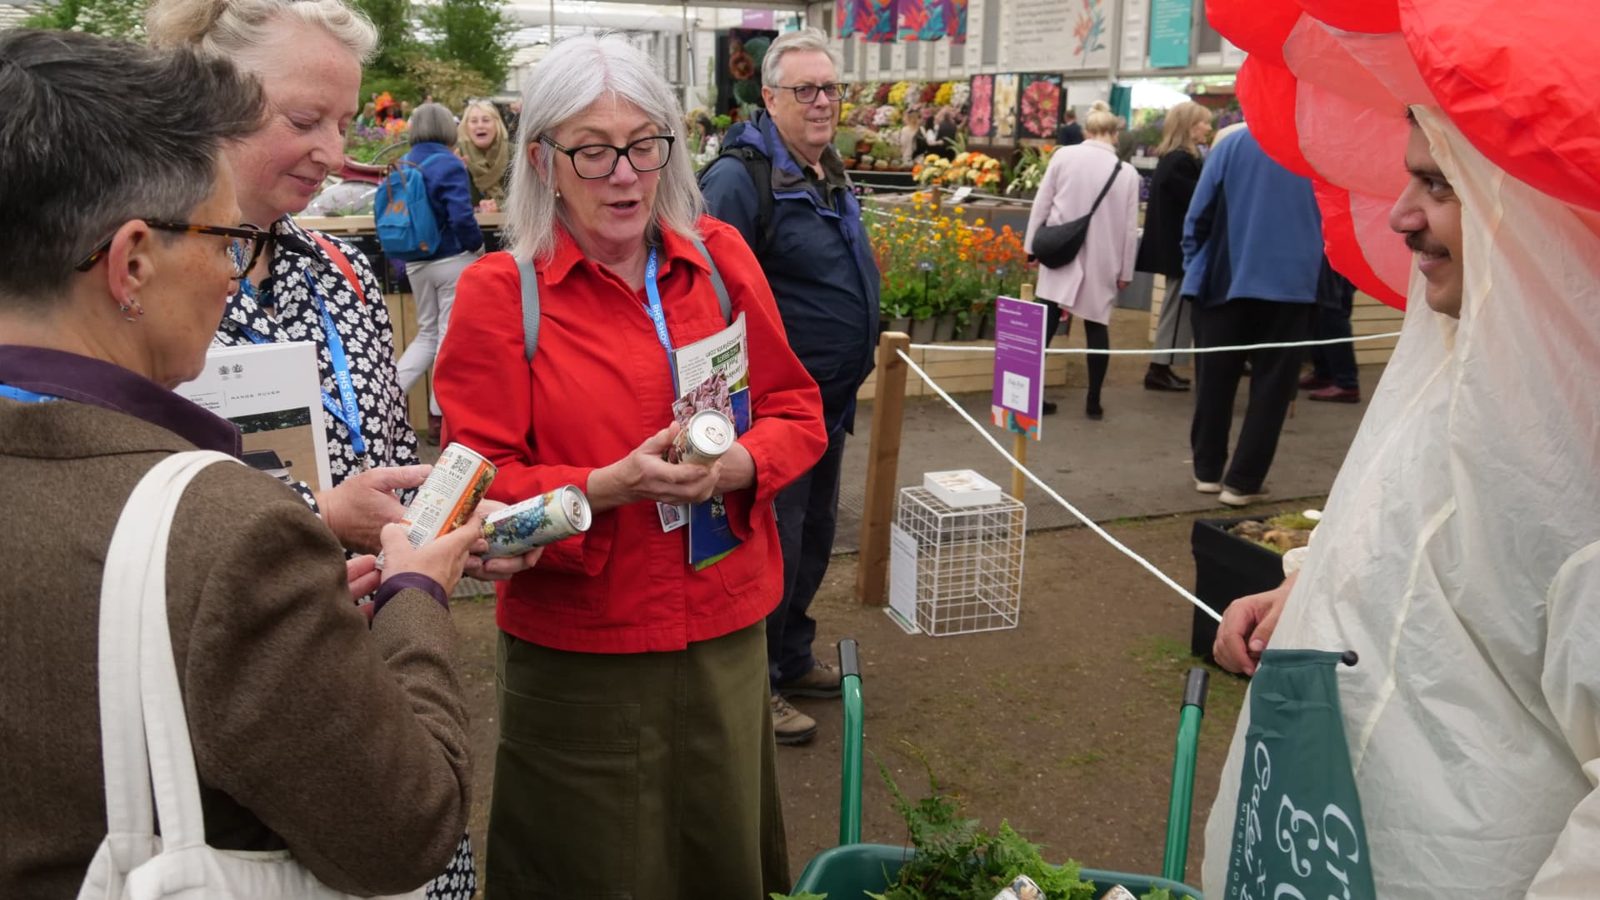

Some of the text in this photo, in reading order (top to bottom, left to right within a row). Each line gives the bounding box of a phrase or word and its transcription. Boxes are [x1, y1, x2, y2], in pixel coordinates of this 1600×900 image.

[652, 304, 662, 321] RHS
[338, 370, 357, 428] RHS SHOWS
[1244, 741, 1271, 875] Caley
[1275, 793, 1320, 878] &
[1323, 803, 1360, 900] Gr
